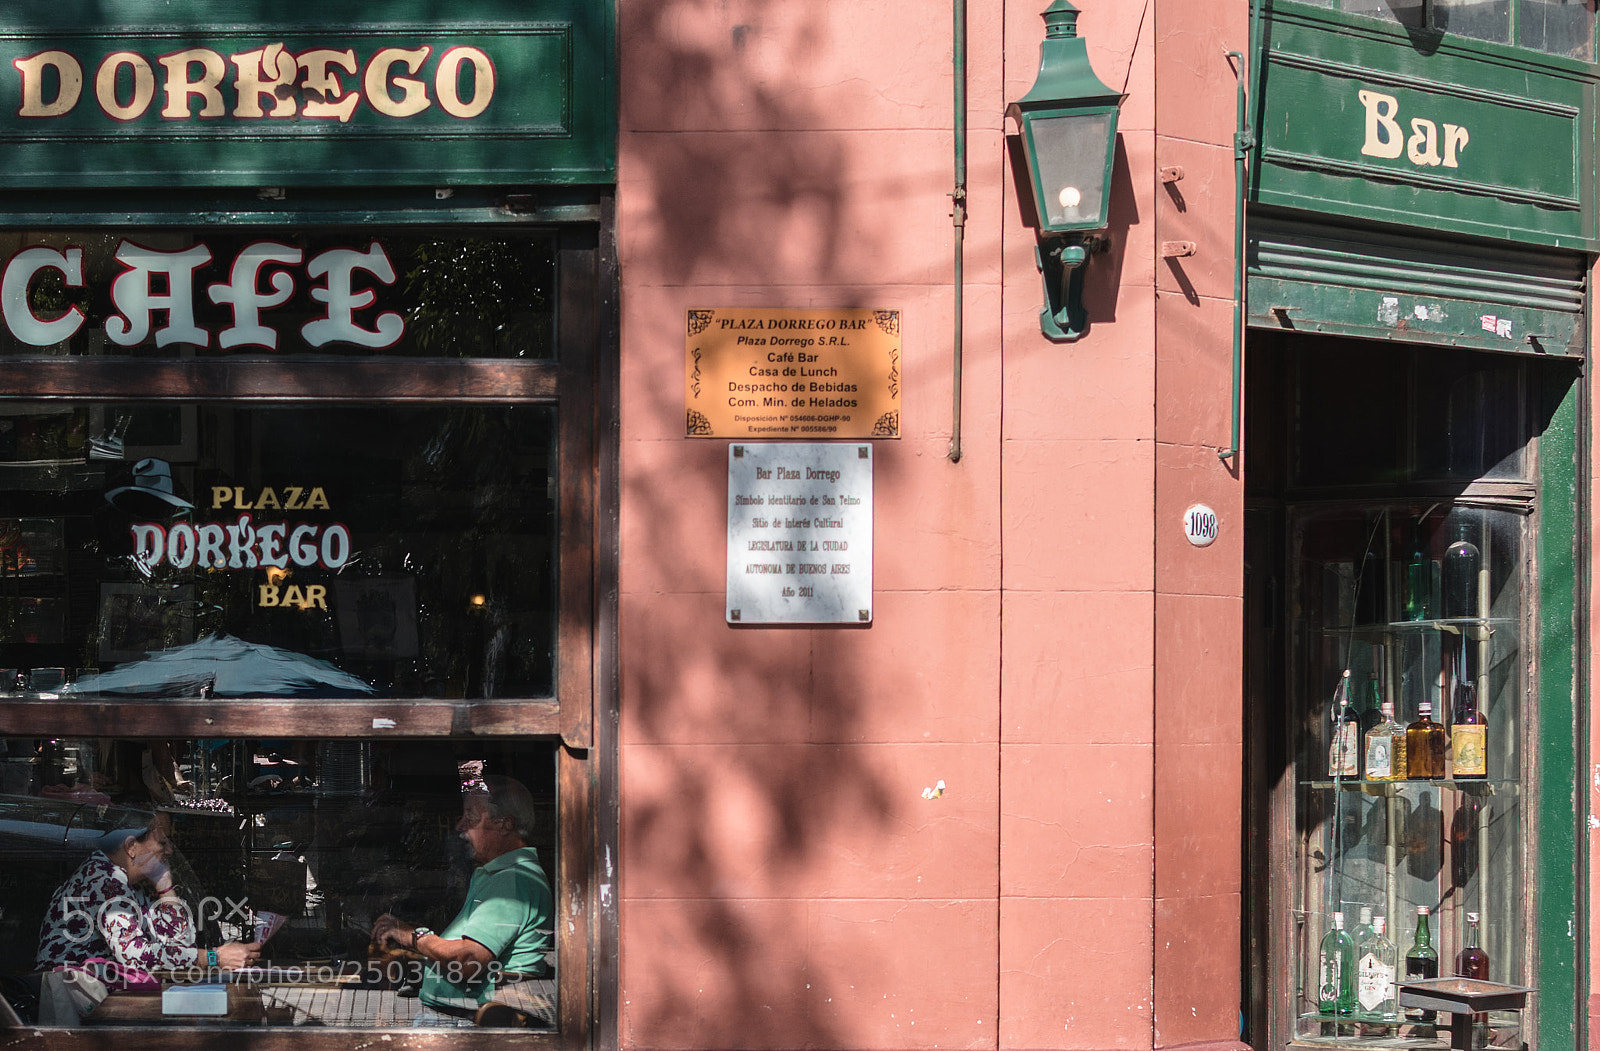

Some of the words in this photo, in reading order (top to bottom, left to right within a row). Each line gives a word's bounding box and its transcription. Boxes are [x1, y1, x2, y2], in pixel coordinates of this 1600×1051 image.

[13, 42, 497, 122] DORREGO
[1358, 89, 1470, 168] Bar
[0, 240, 406, 350] CAFE
[768, 318, 836, 330] DORREGO
[737, 336, 766, 346] Plaza
[770, 336, 815, 348] Dorrego
[818, 336, 850, 346] S.R.L.
[767, 352, 795, 363] Café
[798, 353, 819, 363] Bar
[749, 367, 779, 377] Casa
[782, 367, 797, 377] de
[800, 367, 838, 377] Lunch
[728, 382, 788, 394] Despacho
[791, 382, 806, 392] de
[809, 382, 858, 392] Bebidas
[728, 397, 759, 407] Com.
[763, 397, 788, 407] Min.
[791, 397, 806, 407] de
[809, 397, 858, 407] Helados
[748, 426, 789, 434] Expediente
[756, 467, 772, 480] Bar
[777, 467, 801, 480] Plaza
[806, 467, 841, 483] Dorrego
[211, 485, 330, 510] PLAZA
[768, 495, 807, 505] identitario
[809, 495, 819, 505] de
[822, 495, 836, 505] San
[839, 495, 861, 505] Telmo
[752, 517, 769, 528] Sitio
[772, 517, 782, 528] de
[785, 517, 811, 528] Interés
[813, 517, 844, 528] Cultural
[1190, 511, 1216, 539] 1098
[130, 514, 350, 570] DORREGO
[747, 541, 793, 552] LEGISLATURA
[797, 541, 807, 551] DE
[810, 541, 820, 551] LA
[822, 541, 848, 551] CIUDAD
[745, 563, 782, 574] AUTONOMA
[785, 563, 796, 574] DE
[798, 563, 827, 574] BUENOS
[830, 563, 851, 574] AIRES
[257, 584, 328, 610] BAR
[781, 586, 795, 598] Año
[798, 587, 814, 597] 2011
